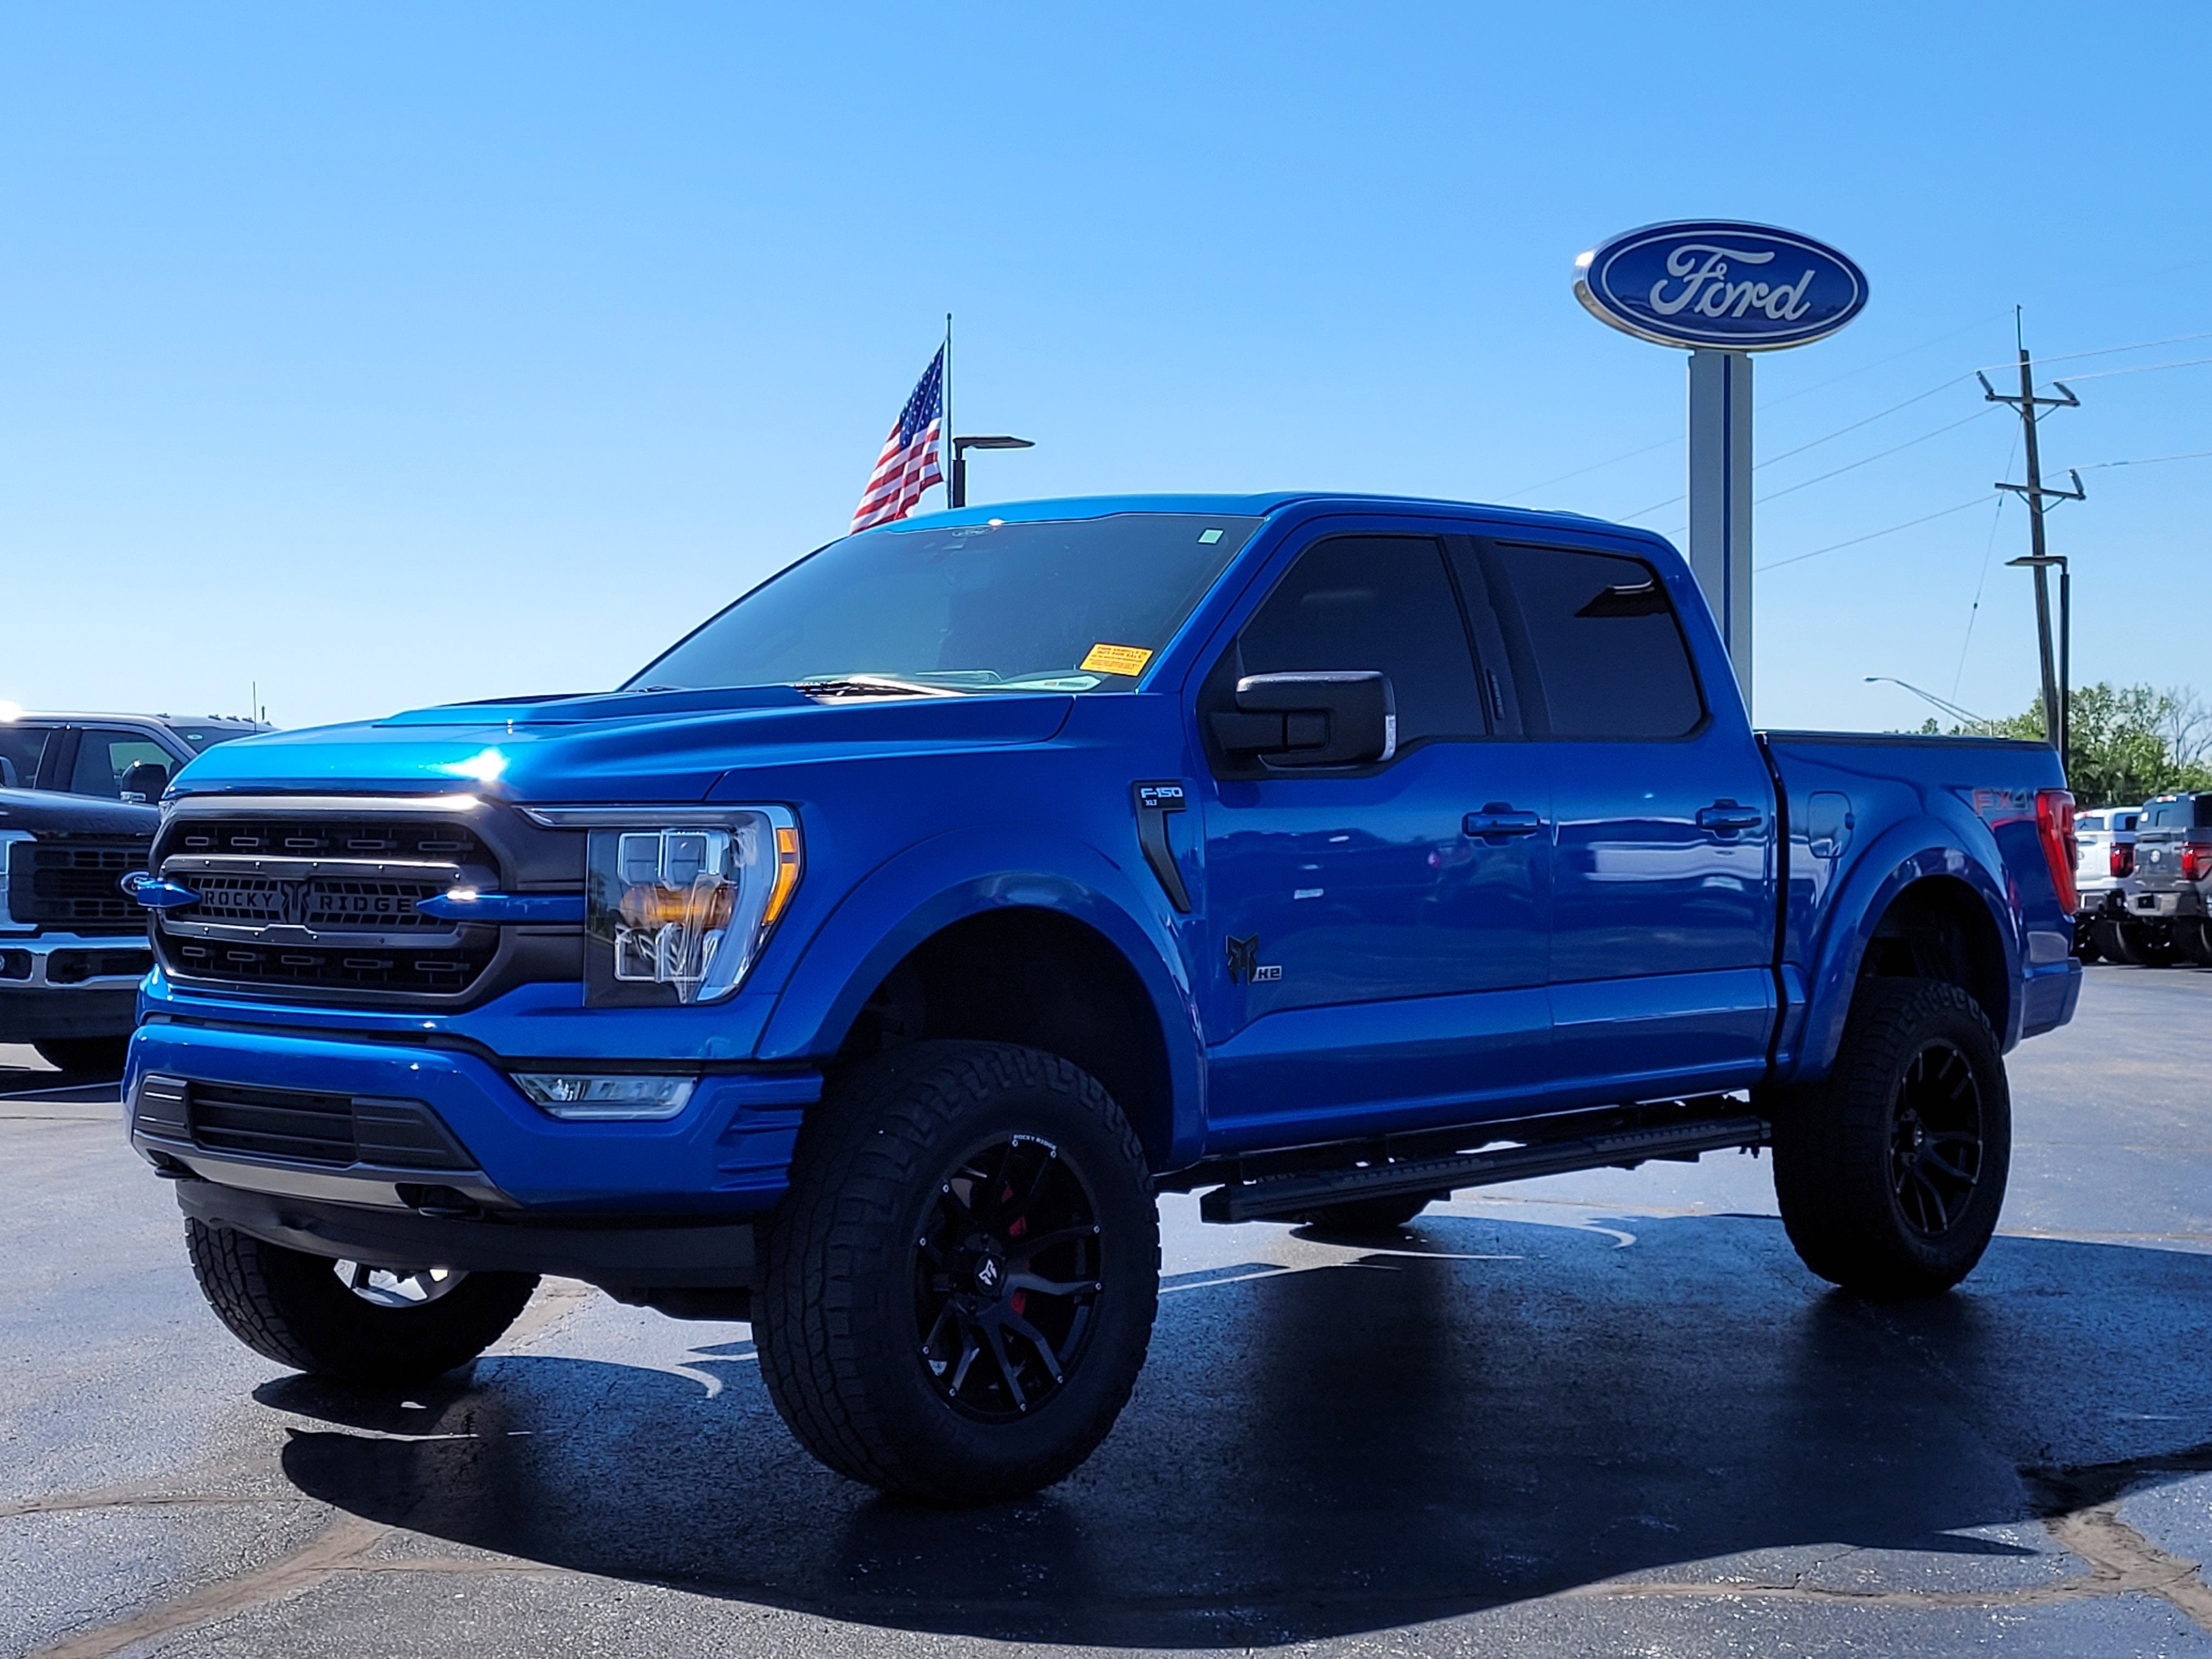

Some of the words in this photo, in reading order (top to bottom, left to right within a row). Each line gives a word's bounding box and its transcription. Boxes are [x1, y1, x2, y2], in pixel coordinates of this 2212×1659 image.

[1649, 244, 1815, 321] Ford
[1141, 787, 1183, 798] F-150
[1973, 789, 2030, 815] FX4
[205, 890, 274, 908] ROCKY
[319, 895, 412, 913] RIDGE
[1258, 968, 1280, 979] K2
